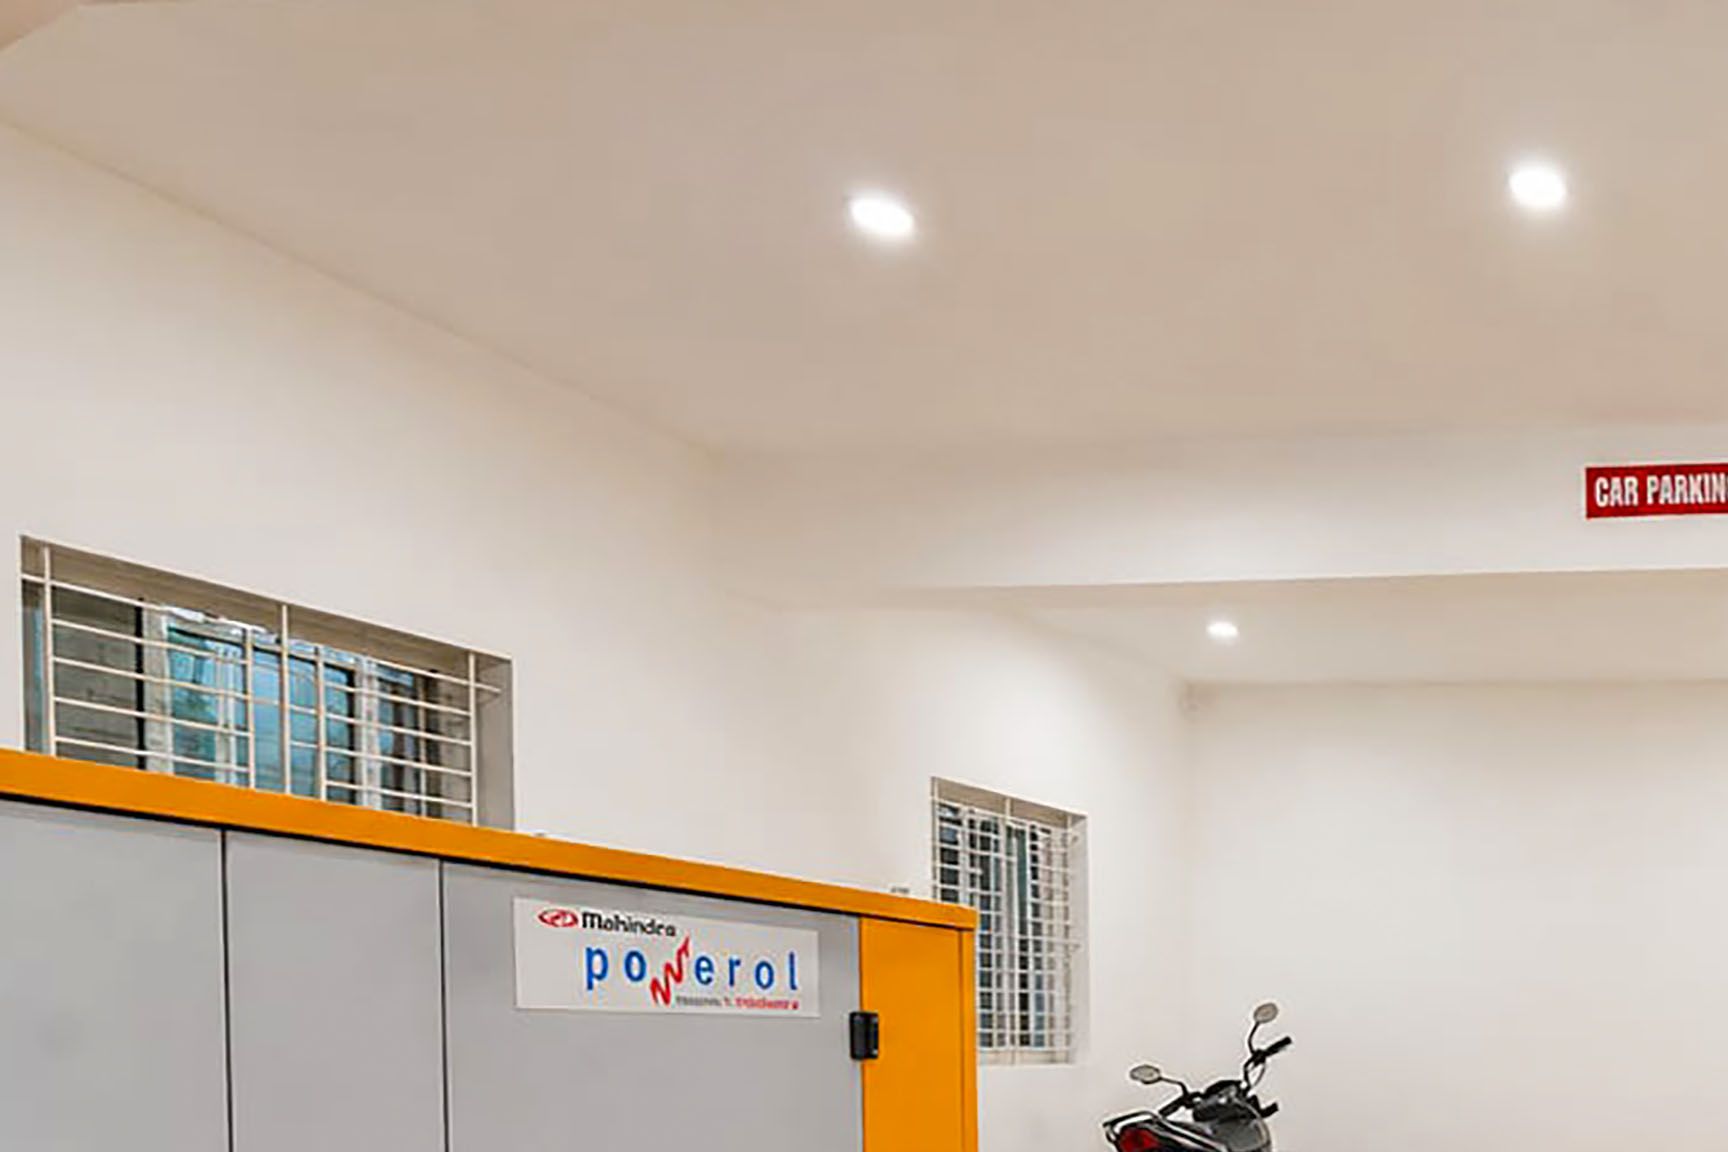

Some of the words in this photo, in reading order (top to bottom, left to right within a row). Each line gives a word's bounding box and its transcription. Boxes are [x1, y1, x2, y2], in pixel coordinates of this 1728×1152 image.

[1595, 476, 1639, 508] CAR
[581, 911, 676, 937] Mahindra
[584, 937, 798, 1006] powerol
